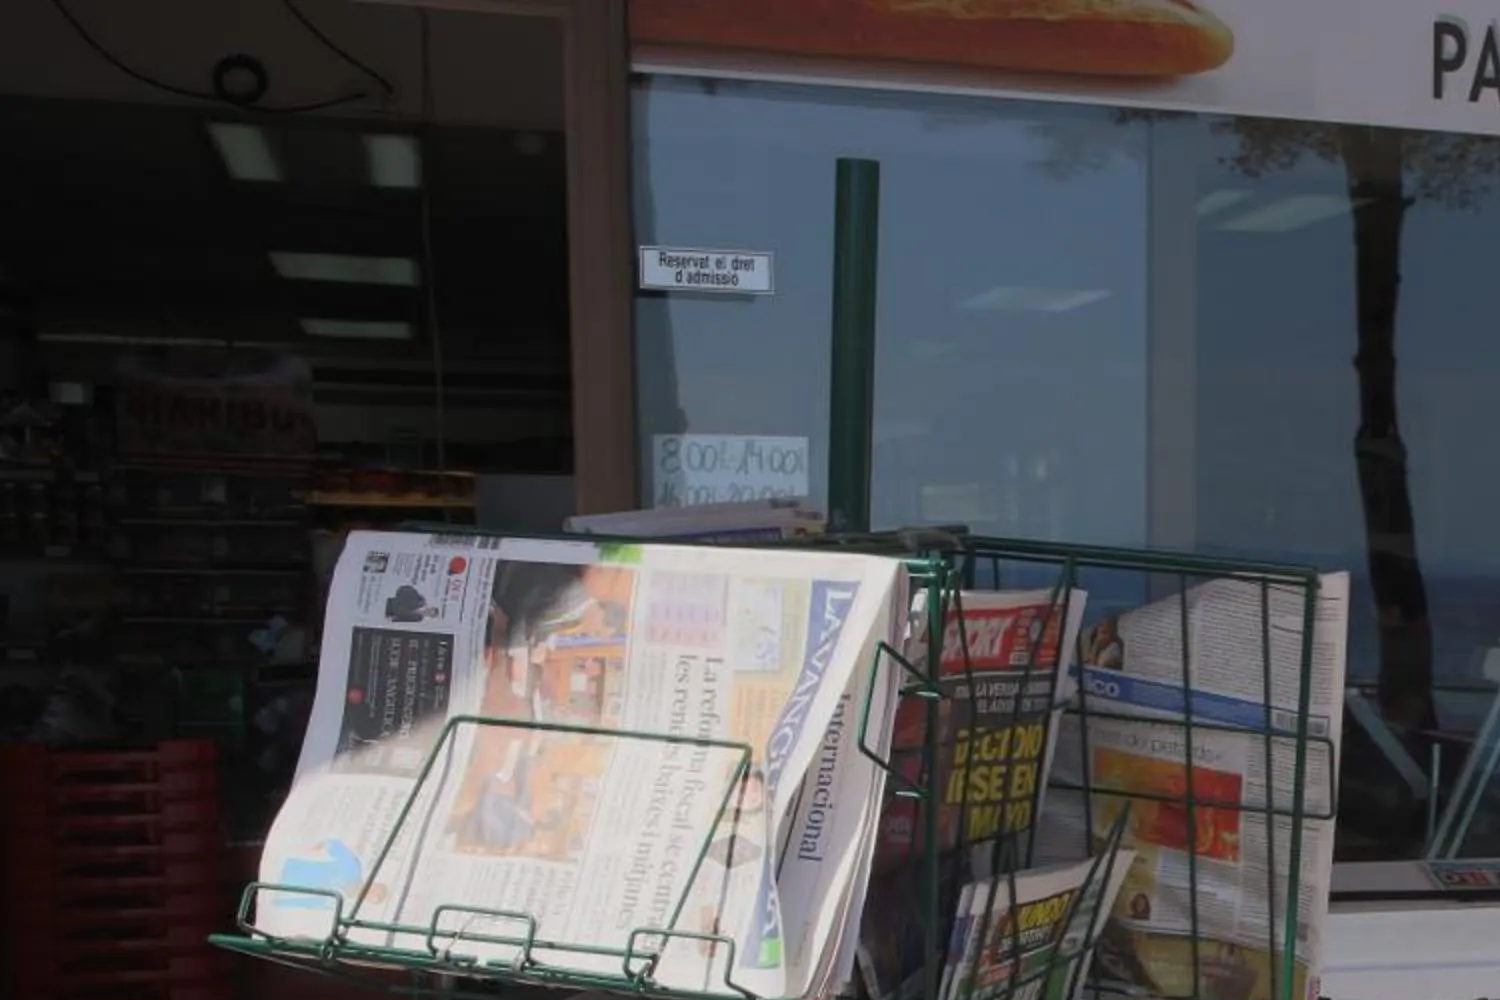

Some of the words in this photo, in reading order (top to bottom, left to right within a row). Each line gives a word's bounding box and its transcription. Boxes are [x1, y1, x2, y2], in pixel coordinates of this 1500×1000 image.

[658, 251, 710, 269] Reservat
[797, 693, 851, 864] Internacional
[672, 779, 706, 829] fiscal
